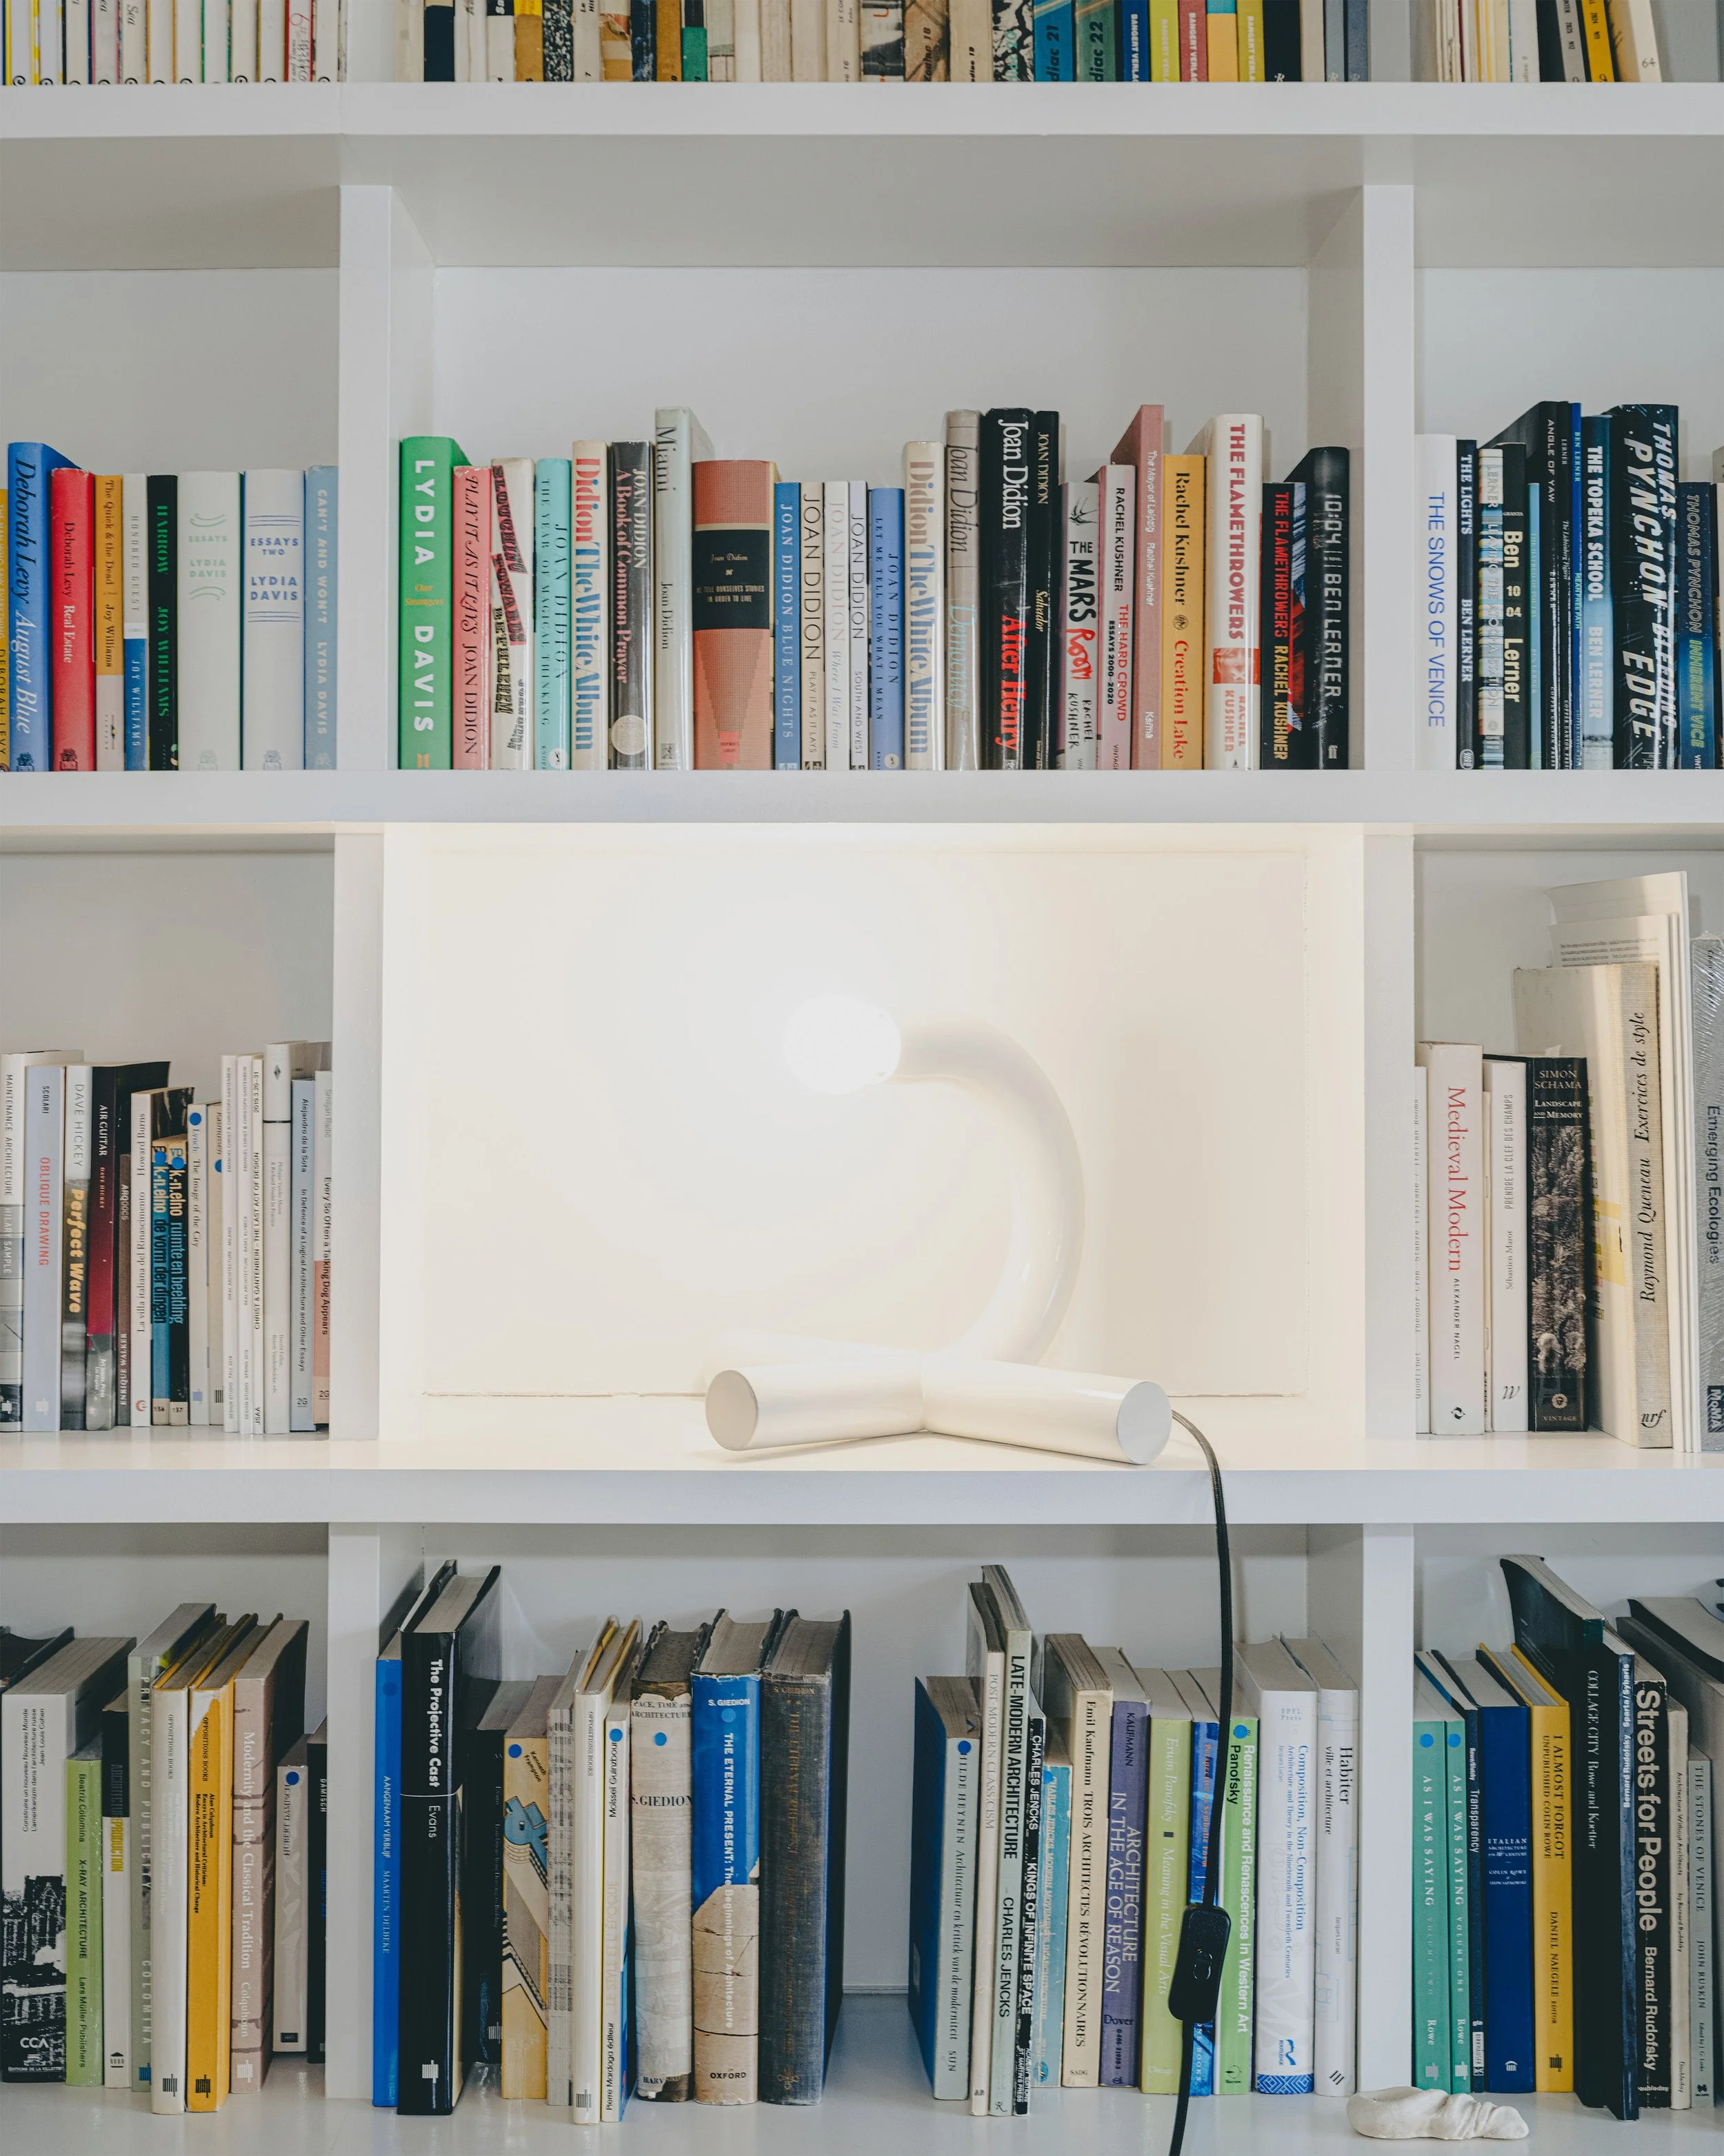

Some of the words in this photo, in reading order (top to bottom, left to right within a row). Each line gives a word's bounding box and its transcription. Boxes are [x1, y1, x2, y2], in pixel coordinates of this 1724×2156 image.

[128, 4, 138, 25] Sea
[1047, 25, 1059, 42] 21
[1090, 21, 1103, 43] 22
[656, 426, 676, 493] Miami
[999, 419, 1028, 461] Joan
[1230, 424, 1245, 462] THE
[1587, 446, 1603, 472] THE
[14, 459, 36, 551] Deborah
[105, 481, 114, 498] The
[415, 461, 434, 565] LYDIA
[1003, 465, 1029, 529] Didion
[1114, 488, 1125, 534] RACHEL
[1175, 472, 1190, 529] Rachel
[1429, 492, 1445, 530] THE
[1587, 478, 1603, 537] TOPEKA
[105, 502, 115, 529] Quick
[781, 504, 792, 551] JOAN
[852, 514, 863, 563] JOAN
[63, 523, 75, 569] Deborah
[106, 542, 114, 557] the
[157, 505, 168, 574] HARROW
[251, 538, 299, 546] ESSAYS
[1070, 541, 1093, 553] THE
[1229, 468, 1245, 639] FLAMETHROWERS
[1503, 530, 1523, 567] Ben
[11, 554, 36, 603] Levy
[62, 572, 74, 596] Levy
[105, 561, 114, 585] Dead
[252, 577, 297, 585] LYDIA
[782, 555, 792, 615] DIDION
[1114, 537, 1125, 592] KUSHNER
[1175, 534, 1190, 605] Kushner
[1429, 537, 1445, 614] SNOWS
[1588, 543, 1603, 601] SCHOOL
[102, 605, 114, 621] Joy
[251, 591, 298, 601] DAVIS
[661, 582, 673, 607] Joan
[852, 572, 864, 639] DIDION
[1070, 559, 1096, 622] MARS
[63, 605, 75, 628] Real
[157, 607, 168, 635] JOY
[661, 610, 673, 649] Didion
[1118, 605, 1128, 628] THE
[1429, 621, 1445, 648] OF
[11, 609, 36, 684] August
[63, 632, 75, 663] Estate
[105, 626, 115, 667] Williams
[782, 625, 792, 666] BLUE
[1001, 615, 1026, 674] After
[1118, 632, 1128, 667] HARD
[1589, 627, 1603, 657] BEN
[158, 640, 168, 717] WILLIAMS
[415, 626, 434, 731] DAVIS
[1174, 641, 1189, 714] Creation
[1429, 654, 1445, 727] VENICE
[1503, 638, 1524, 702] Lerner
[1589, 663, 1603, 718] LERNER
[16, 684, 36, 733] Blue
[783, 676, 792, 738] NIGHTS
[995, 680, 1026, 751] Henry
[1116, 672, 1127, 721] CROWD
[1174, 721, 1188, 759] Lake
[1630, 1012, 1645, 1043] style
[1631, 1049, 1645, 1066] de
[74, 1084, 84, 1116] DAVE
[99, 1105, 107, 1120] AIR
[1632, 1073, 1650, 1142] Exercices
[74, 1121, 83, 1166] HICKEY
[99, 1122, 107, 1156] GUITAR
[1447, 1087, 1467, 1181] Medieval
[4, 1137, 12, 1196] ARCHITECTURE
[39, 1158, 50, 1205] OBLIQUE
[321, 1177, 331, 1199] Every
[323, 1202, 330, 1214] So
[1637, 1158, 1655, 1224] Queneau
[3, 1208, 12, 1238] HILARY
[39, 1211, 49, 1266] DRAWING
[66, 1188, 85, 1256] Perfect
[1447, 1189, 1466, 1271] Modern
[3, 1240, 12, 1273] SAMPLE
[321, 1249, 330, 1279] Talking
[1637, 1232, 1661, 1302] Raymond
[69, 1262, 83, 1313] Wave
[320, 1282, 330, 1297] Dog
[320, 1300, 329, 1335] Appears
[430, 1659, 442, 1684] The
[427, 1687, 442, 1753] Projective
[1008, 1655, 1025, 1753] LATE-MODERN
[725, 1733, 733, 1753] THE
[1636, 1690, 1661, 1788] Streets
[239, 1732, 255, 1799] Modernity
[430, 1756, 442, 1786] Cast
[725, 1757, 733, 1807] ETERNAL
[1227, 1745, 1241, 1804] Panofsky
[1338, 1747, 1353, 1805] Habiter
[1553, 1745, 1564, 1800] ALMOST
[243, 1802, 254, 1825] and
[428, 1805, 440, 1837] Evans
[1004, 1757, 1021, 1859] ARCHITECTURE
[1111, 1792, 1126, 1813] IN
[1468, 1789, 1481, 1853] Transparency
[1638, 1794, 1661, 1833] for
[243, 1829, 254, 1848] the
[724, 1811, 733, 1864] PRESENT:
[1110, 1817, 1126, 1850] THE
[1554, 1805, 1564, 1859] FORGOT
[242, 1853, 255, 1907] Classical
[1110, 1855, 1124, 1893] AGE
[1121, 1826, 1139, 1962] ARCHITECTURE
[1636, 1837, 1661, 1931] People
[79, 1891, 87, 1958] ARCHITECTURE
[1000, 1897, 1014, 1960] CHARLES
[1108, 1897, 1123, 1922] OF
[241, 1911, 254, 1968] Tradition
[1106, 1925, 1121, 1992] REASON
[1000, 1964, 1013, 2017] JENCKS
[1643, 1946, 1657, 2002] Bernard
[79, 1997, 87, 2022] Müller
[78, 2025, 87, 2067] Publishers
[1643, 2005, 1658, 2071] Rudofsky
[710, 2072, 746, 2080] OXFORD
